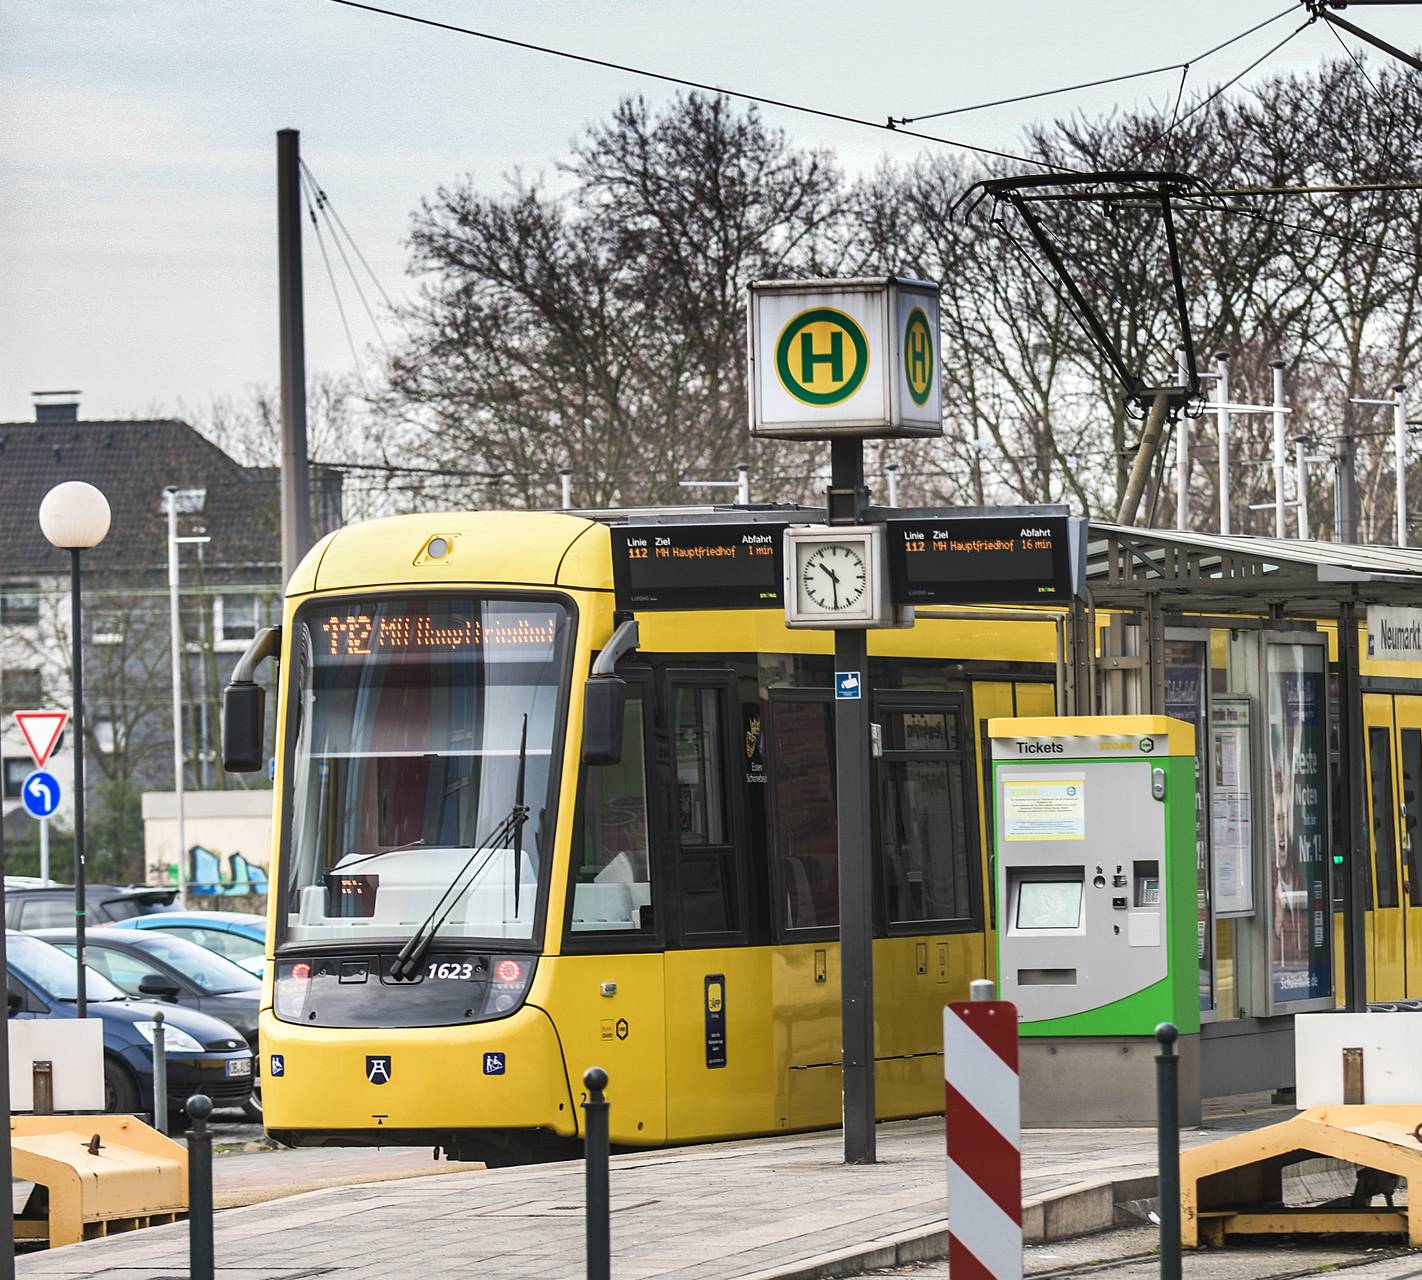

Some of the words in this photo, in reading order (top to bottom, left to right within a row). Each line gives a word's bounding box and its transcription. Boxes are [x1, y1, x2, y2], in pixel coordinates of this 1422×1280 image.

[800, 331, 844, 383] H
[912, 331, 926, 383] H
[627, 537, 648, 547] Linie
[655, 537, 671, 546] Ziel
[742, 535, 773, 544] Abfahrt
[904, 531, 925, 541] Linie
[932, 530, 949, 540] Ziel
[1020, 528, 1051, 538] Abfahrt
[628, 548, 648, 559] 112
[655, 547, 670, 558] MH
[672, 546, 736, 560] Hauptfriedhof
[755, 546, 773, 556] min
[905, 542, 925, 552] 112
[933, 541, 947, 551] MH
[950, 539, 1015, 553] Hauptfriedhof
[1021, 539, 1032, 550] 16
[1035, 540, 1052, 550] min
[1380, 619, 1421, 650] Neumarkt
[1015, 741, 1064, 754] Tickets
[427, 963, 474, 980] 1623
